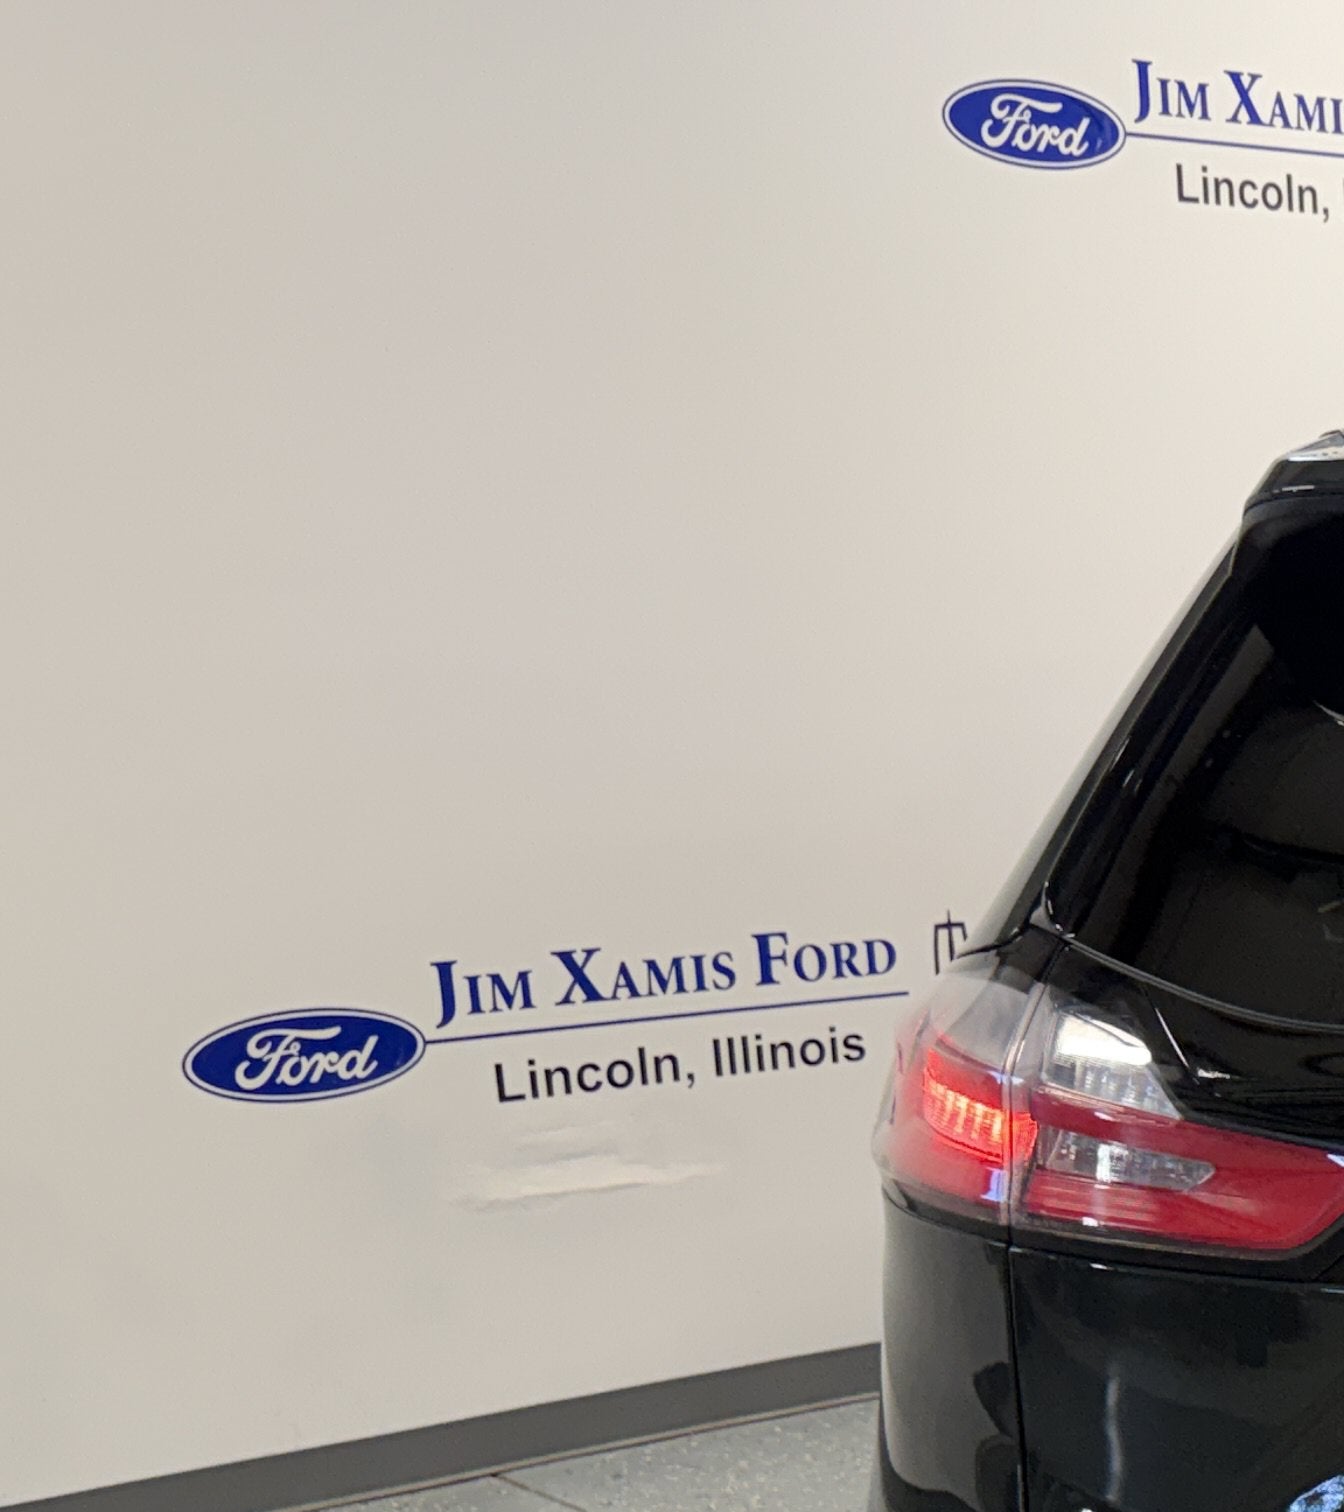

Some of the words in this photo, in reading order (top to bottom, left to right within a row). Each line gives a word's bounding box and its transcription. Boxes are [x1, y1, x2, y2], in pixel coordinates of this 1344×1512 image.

[1131, 59, 1211, 123] JIM
[981, 93, 1089, 157] Ford
[1175, 163, 1330, 222] Lincoln,
[430, 960, 535, 1029] JIM
[550, 947, 737, 1006] XAMIS
[751, 931, 897, 985] FORD
[234, 1026, 378, 1093] Ford
[495, 1047, 695, 1103] Lincoln,
[712, 1026, 866, 1077] Illinois
